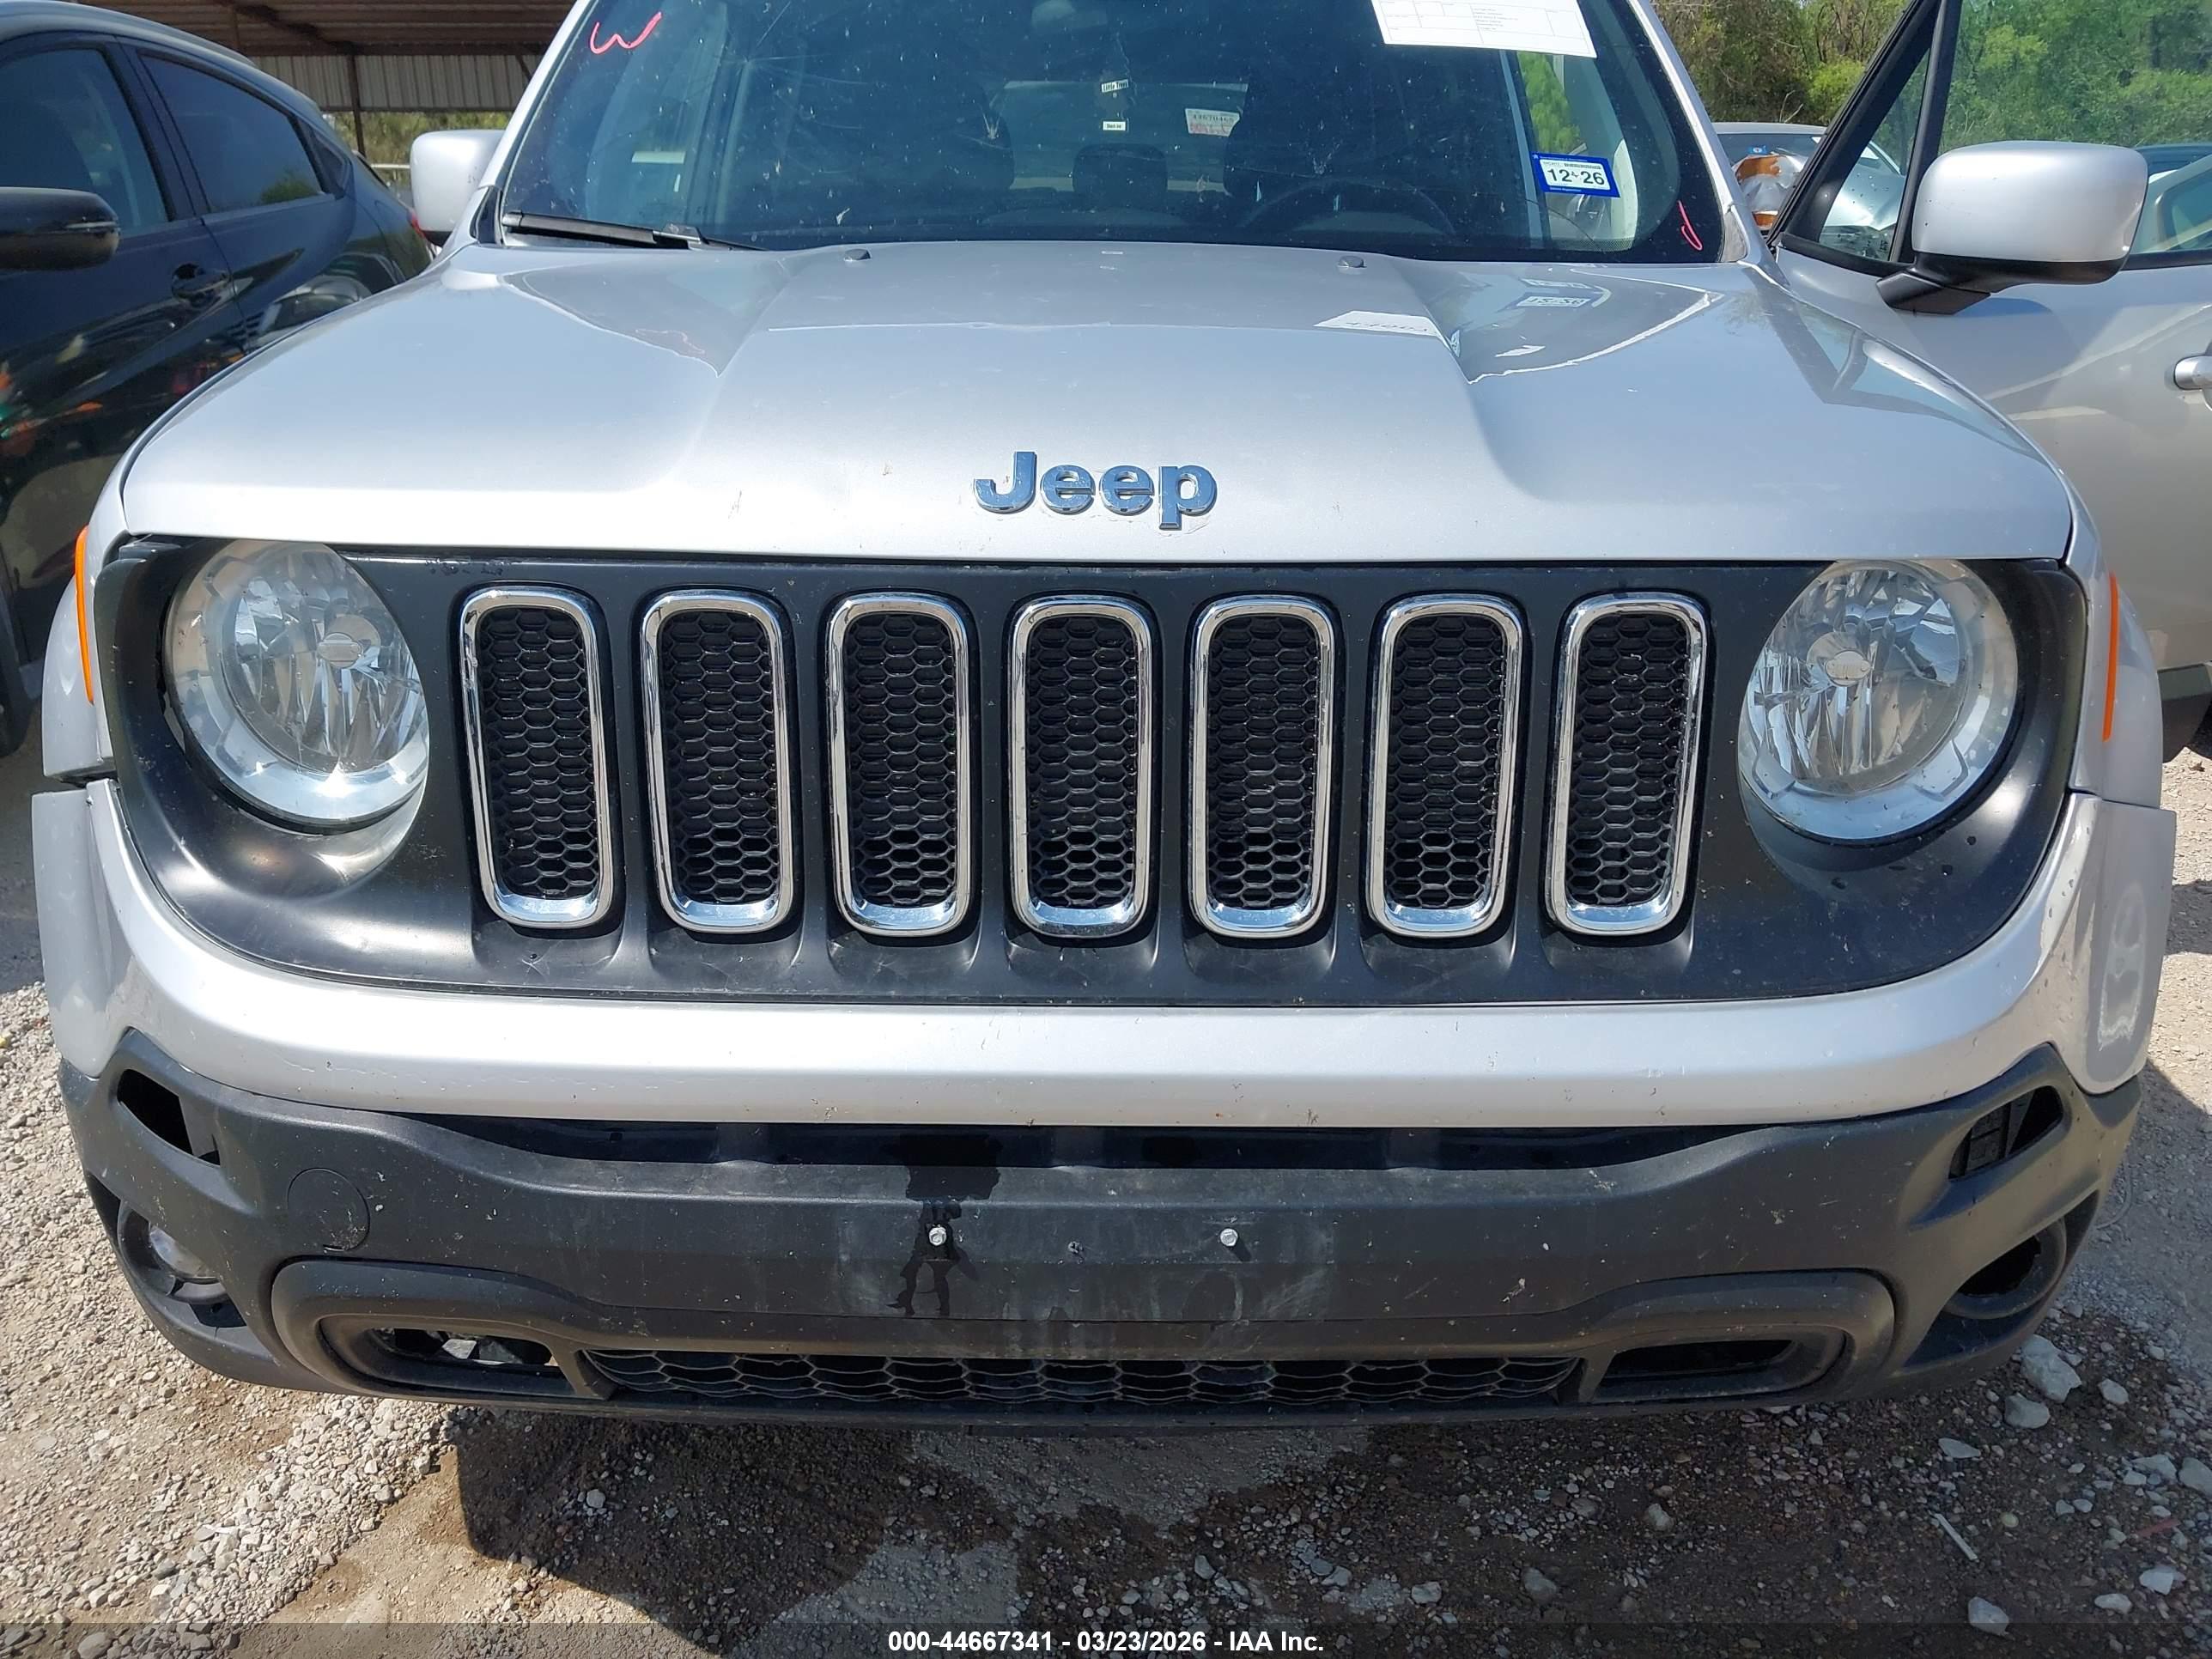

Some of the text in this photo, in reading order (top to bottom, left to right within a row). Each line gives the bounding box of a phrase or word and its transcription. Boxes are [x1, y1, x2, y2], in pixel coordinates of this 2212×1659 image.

[1547, 168, 1605, 185] 12 26
[974, 451, 1218, 530] Jeep
